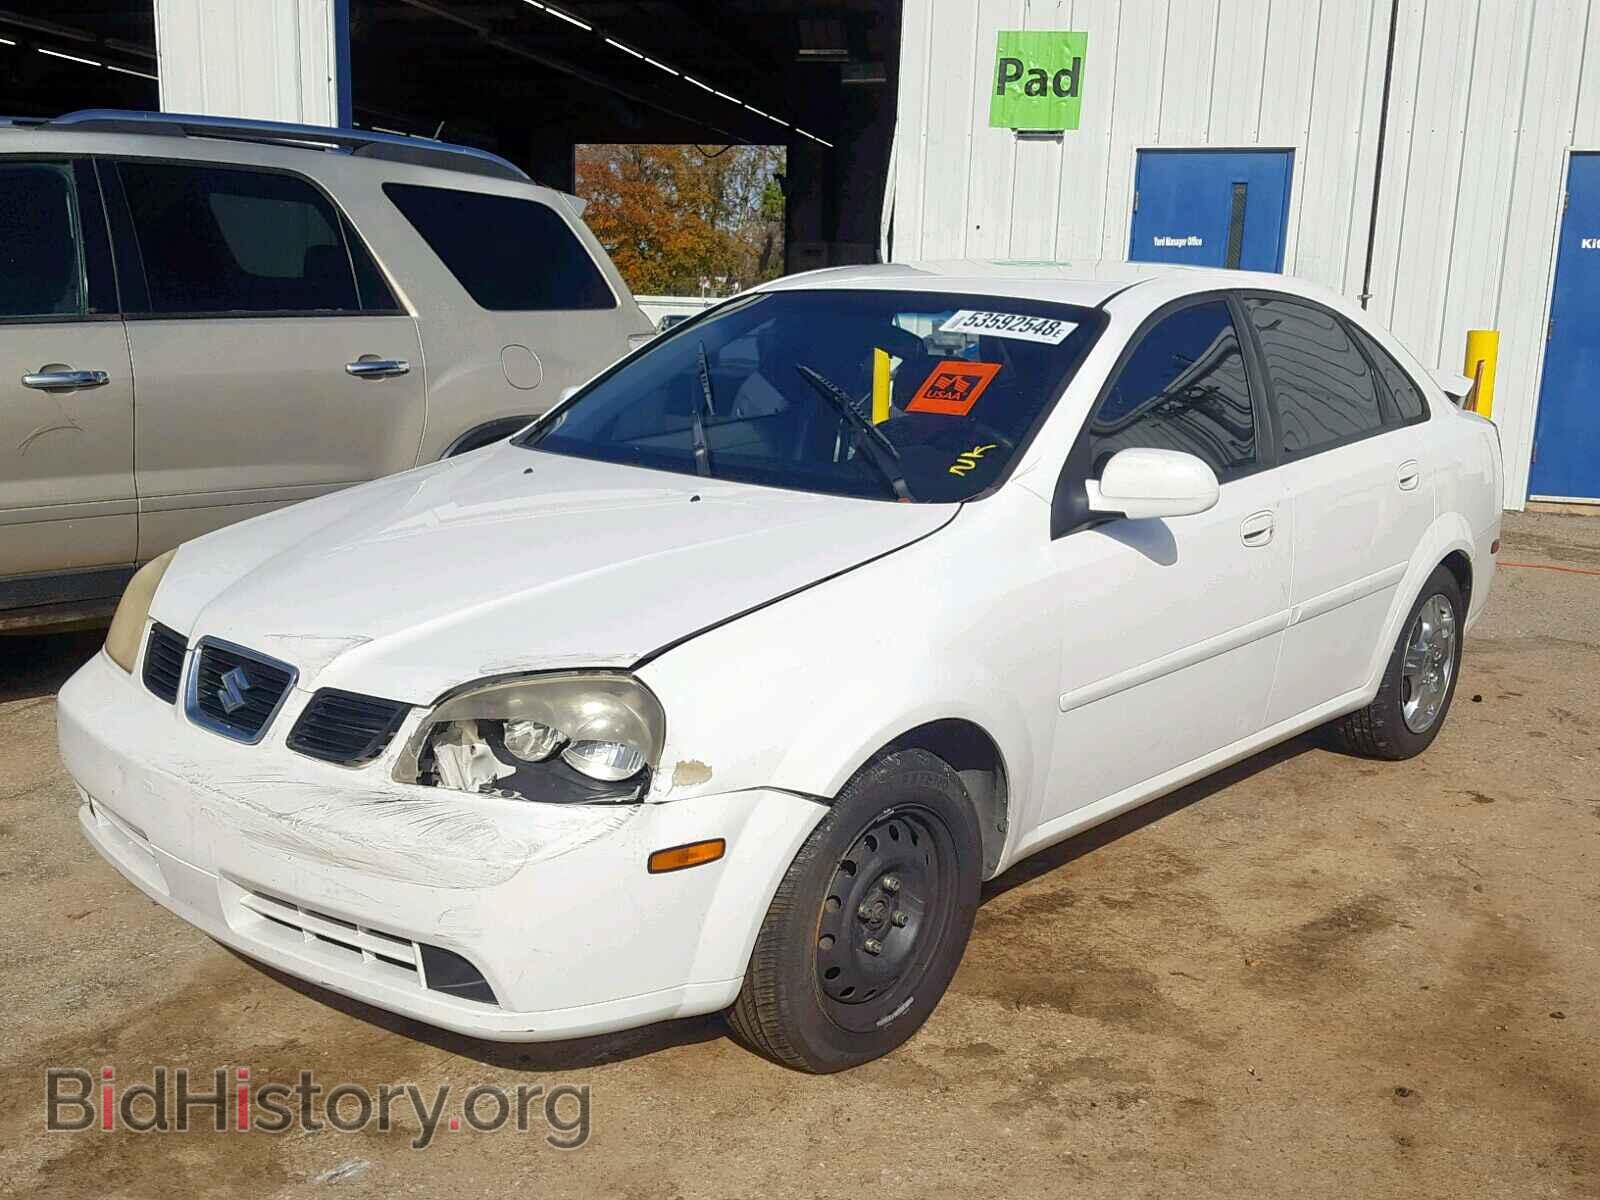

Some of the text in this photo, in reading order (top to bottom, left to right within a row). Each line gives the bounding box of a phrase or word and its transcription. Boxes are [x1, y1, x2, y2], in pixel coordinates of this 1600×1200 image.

[996, 57, 1081, 97] Pad
[1187, 236, 1202, 246] Office
[926, 390, 961, 400] USAA
